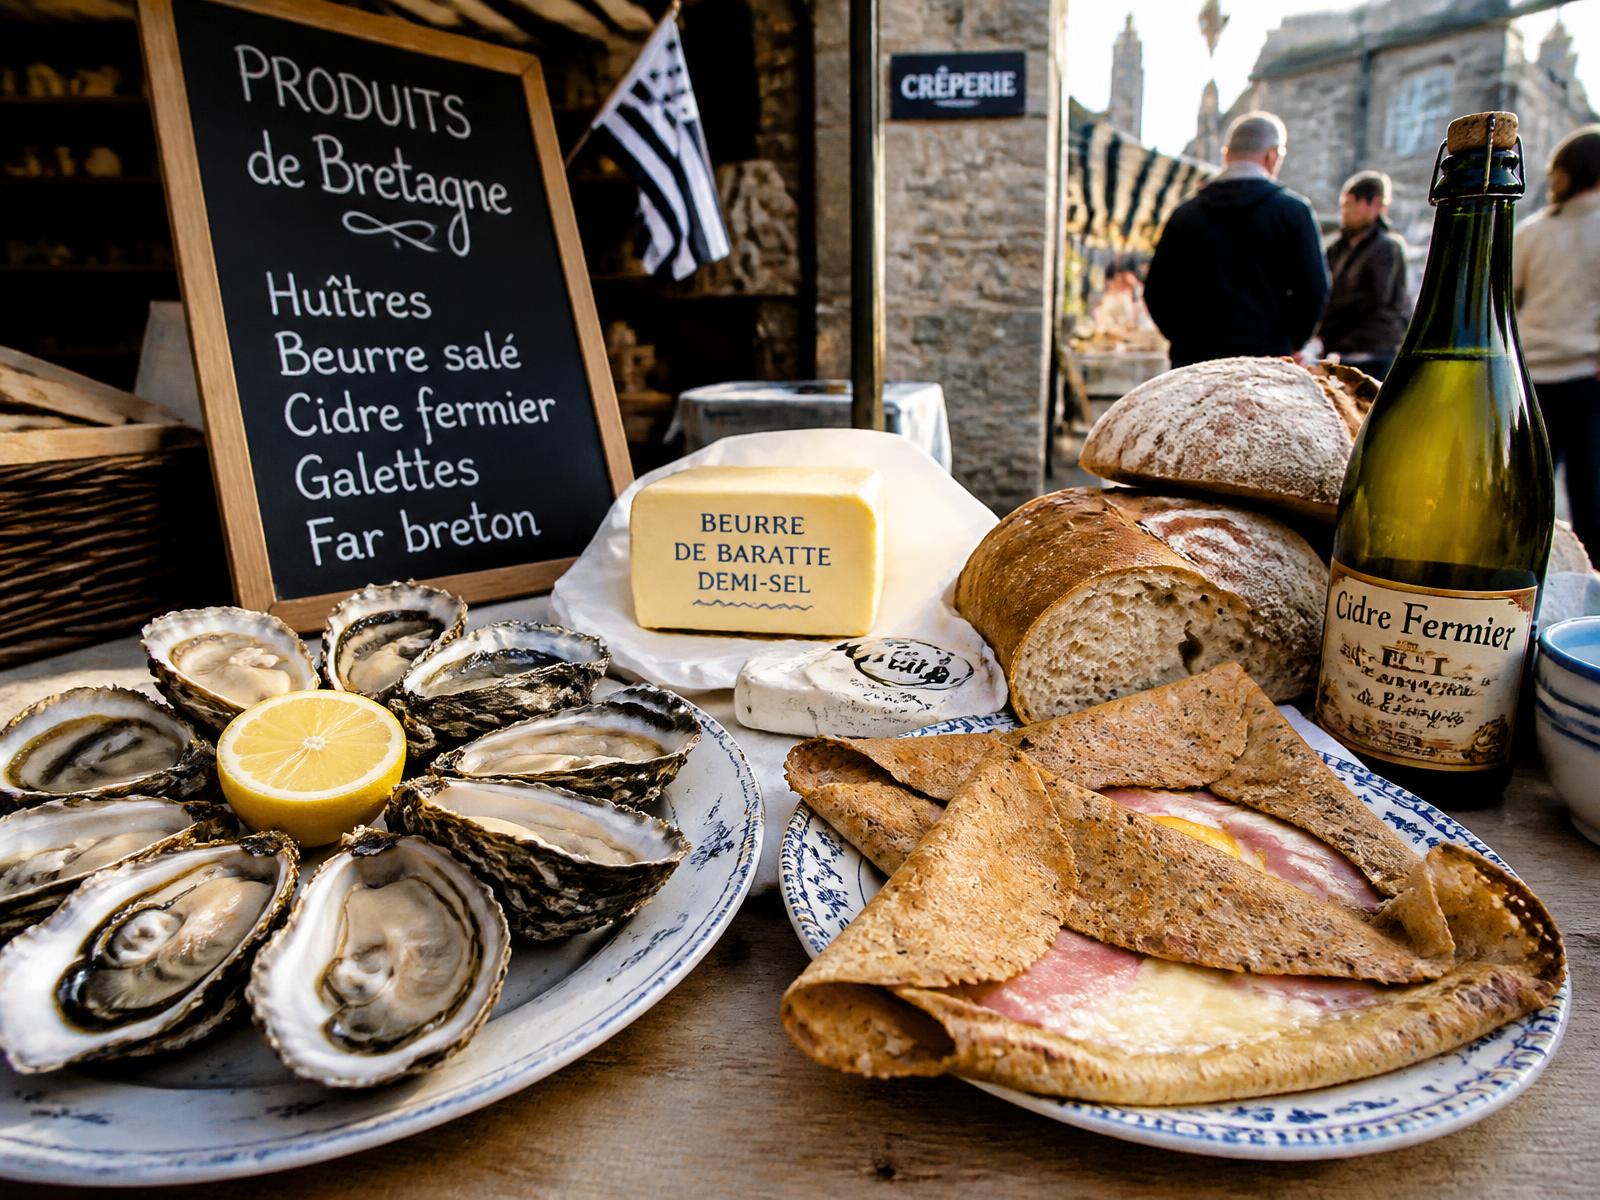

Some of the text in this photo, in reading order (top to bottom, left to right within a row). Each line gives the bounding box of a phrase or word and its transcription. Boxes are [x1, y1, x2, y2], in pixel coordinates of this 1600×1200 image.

[234, 44, 471, 139] PRODUITS
[900, 64, 1017, 99] CRÊPERIE
[247, 129, 512, 256] de Bretagne
[266, 271, 432, 319] Huîtres
[274, 331, 522, 376] Beurre salé
[284, 386, 556, 445] Cidre fermier
[295, 448, 480, 500] Galettes
[306, 501, 541, 566] Far breton
[701, 513, 805, 535] BEURRE
[675, 542, 831, 566] DE BARATTE
[698, 571, 811, 593] DEMI-SEL
[1336, 590, 1516, 650] Cidre Fermier
